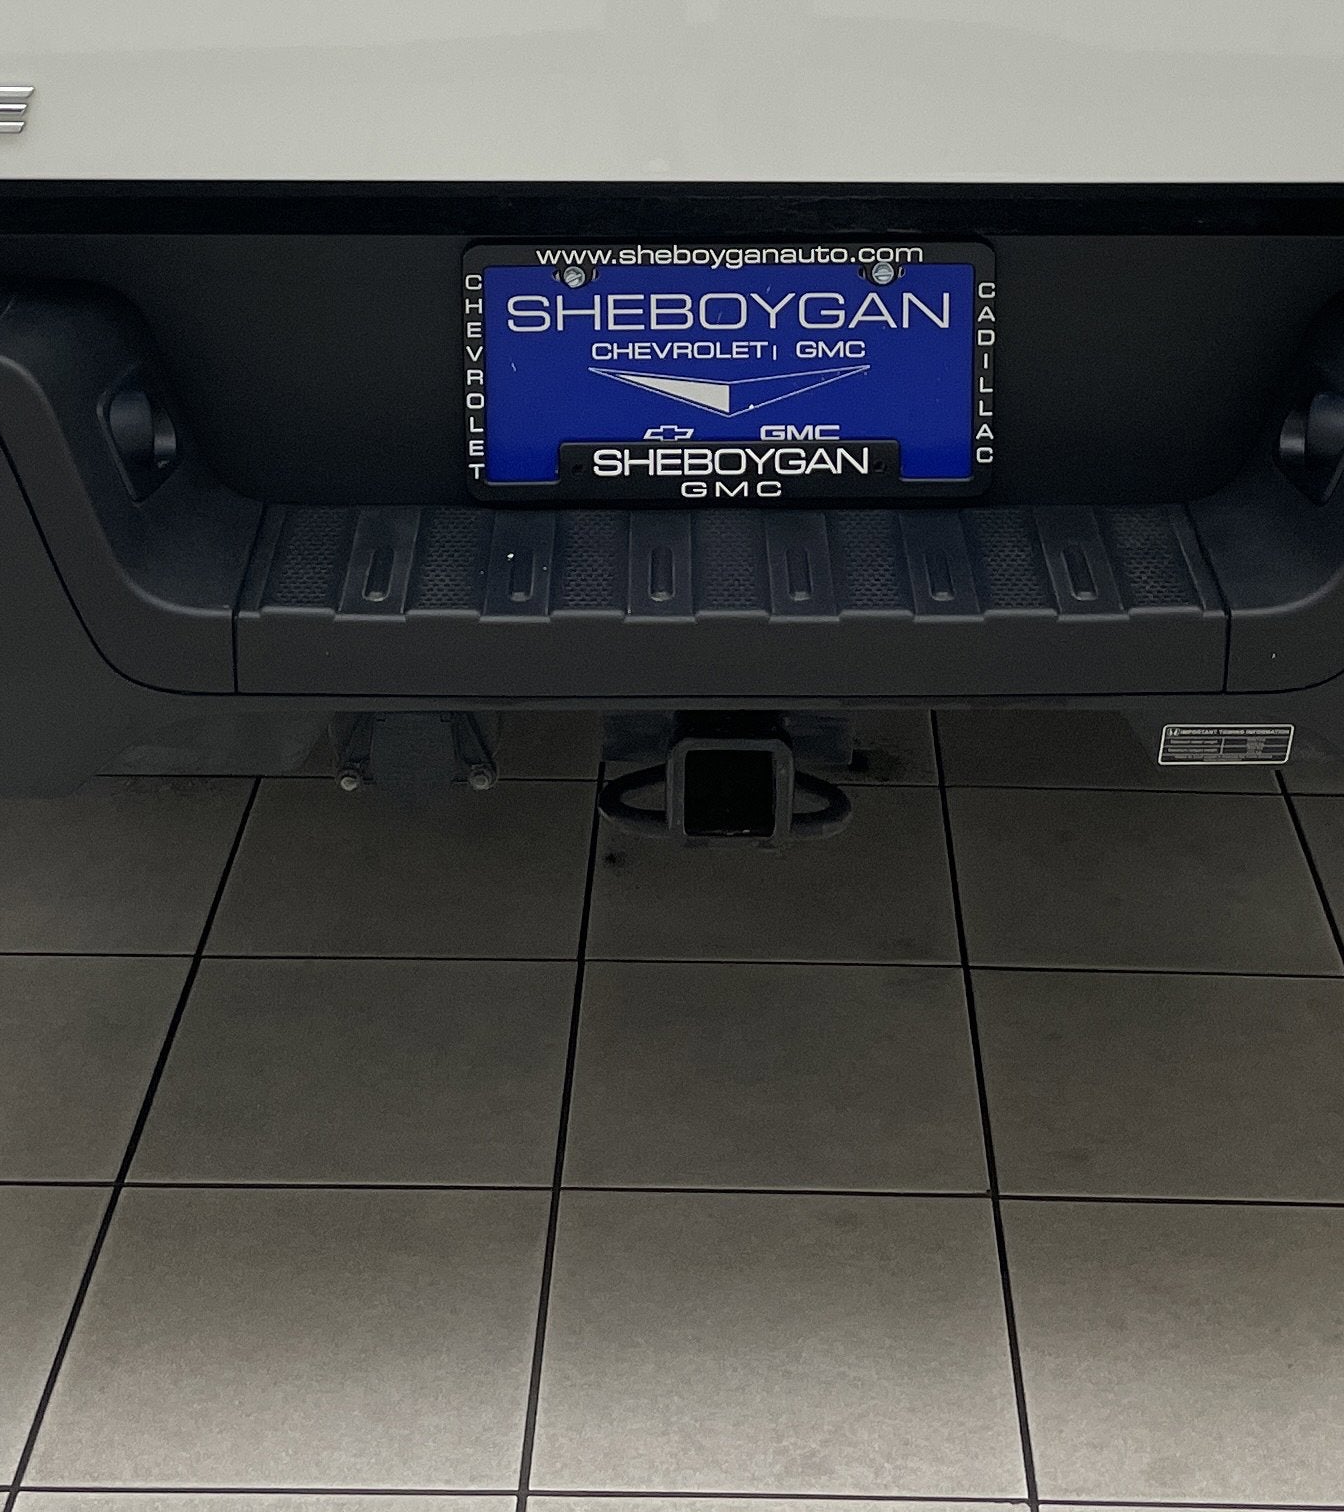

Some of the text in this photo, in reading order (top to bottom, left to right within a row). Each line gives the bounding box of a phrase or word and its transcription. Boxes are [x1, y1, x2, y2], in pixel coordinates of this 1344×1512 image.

[535, 244, 924, 270] www.sheboyganauto.com
[506, 292, 951, 333] SHEBOYGAN
[591, 340, 867, 361] CHEVROLET GMC
[464, 273, 486, 481] CHEVROLET
[975, 281, 997, 465] CADILLAC
[759, 424, 841, 441] GMC
[592, 447, 869, 477] SHEBOYGAN
[680, 480, 783, 498] GMC
